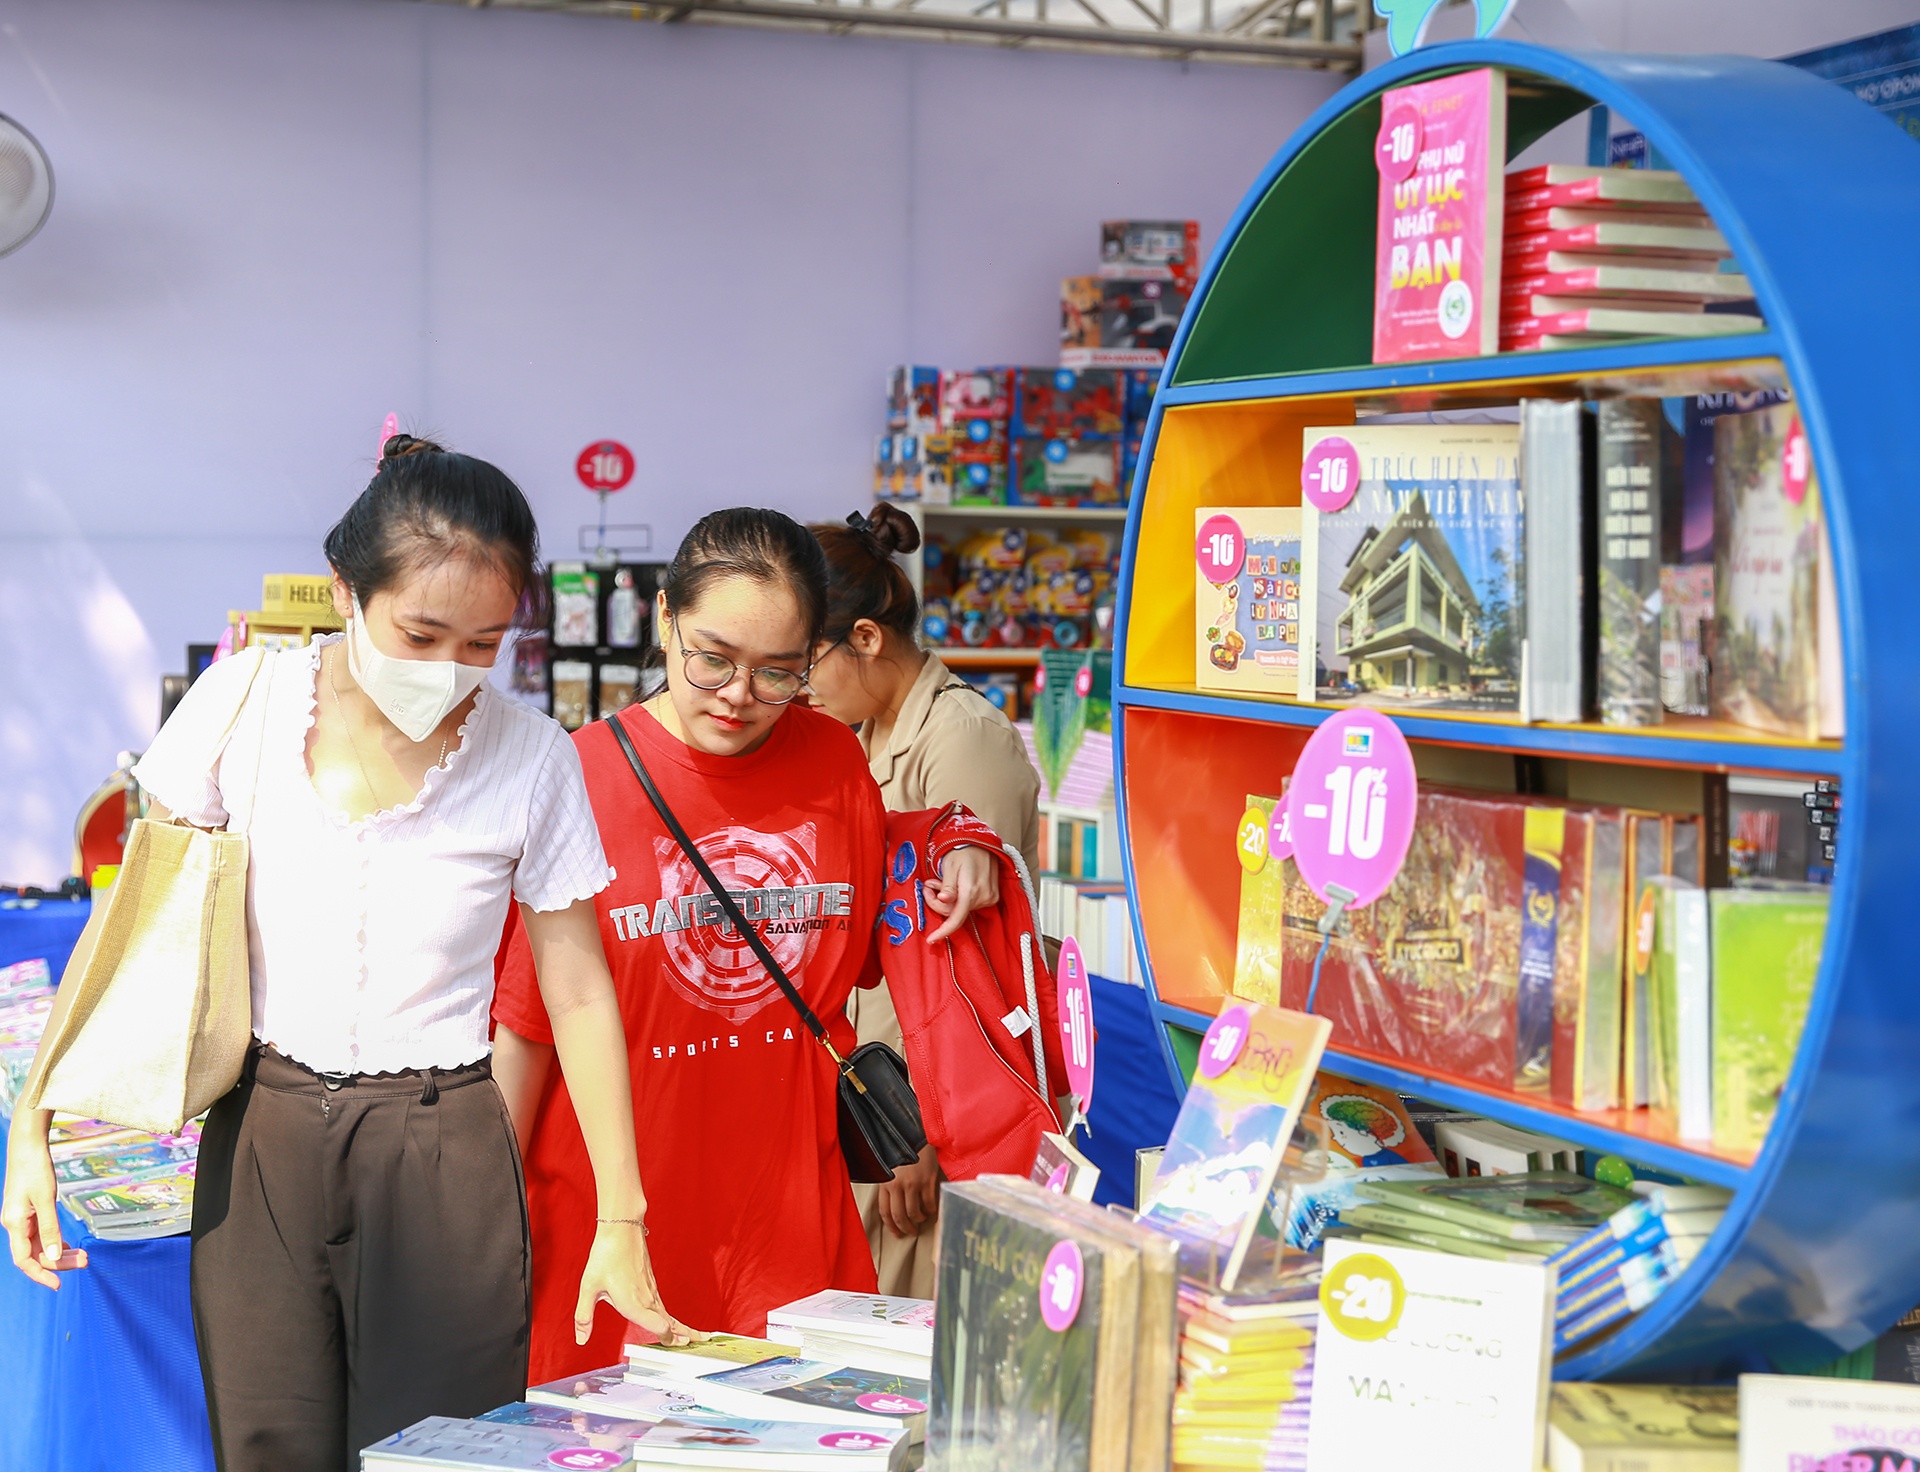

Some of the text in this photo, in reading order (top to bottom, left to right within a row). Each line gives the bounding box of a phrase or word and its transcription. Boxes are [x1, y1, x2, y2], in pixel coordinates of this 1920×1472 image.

[1393, 206, 1437, 239] NHẤT
[1391, 236, 1463, 290] BẠN
[609, 881, 854, 942] TRANSFORME
[766, 919, 830, 935] SALVATION
